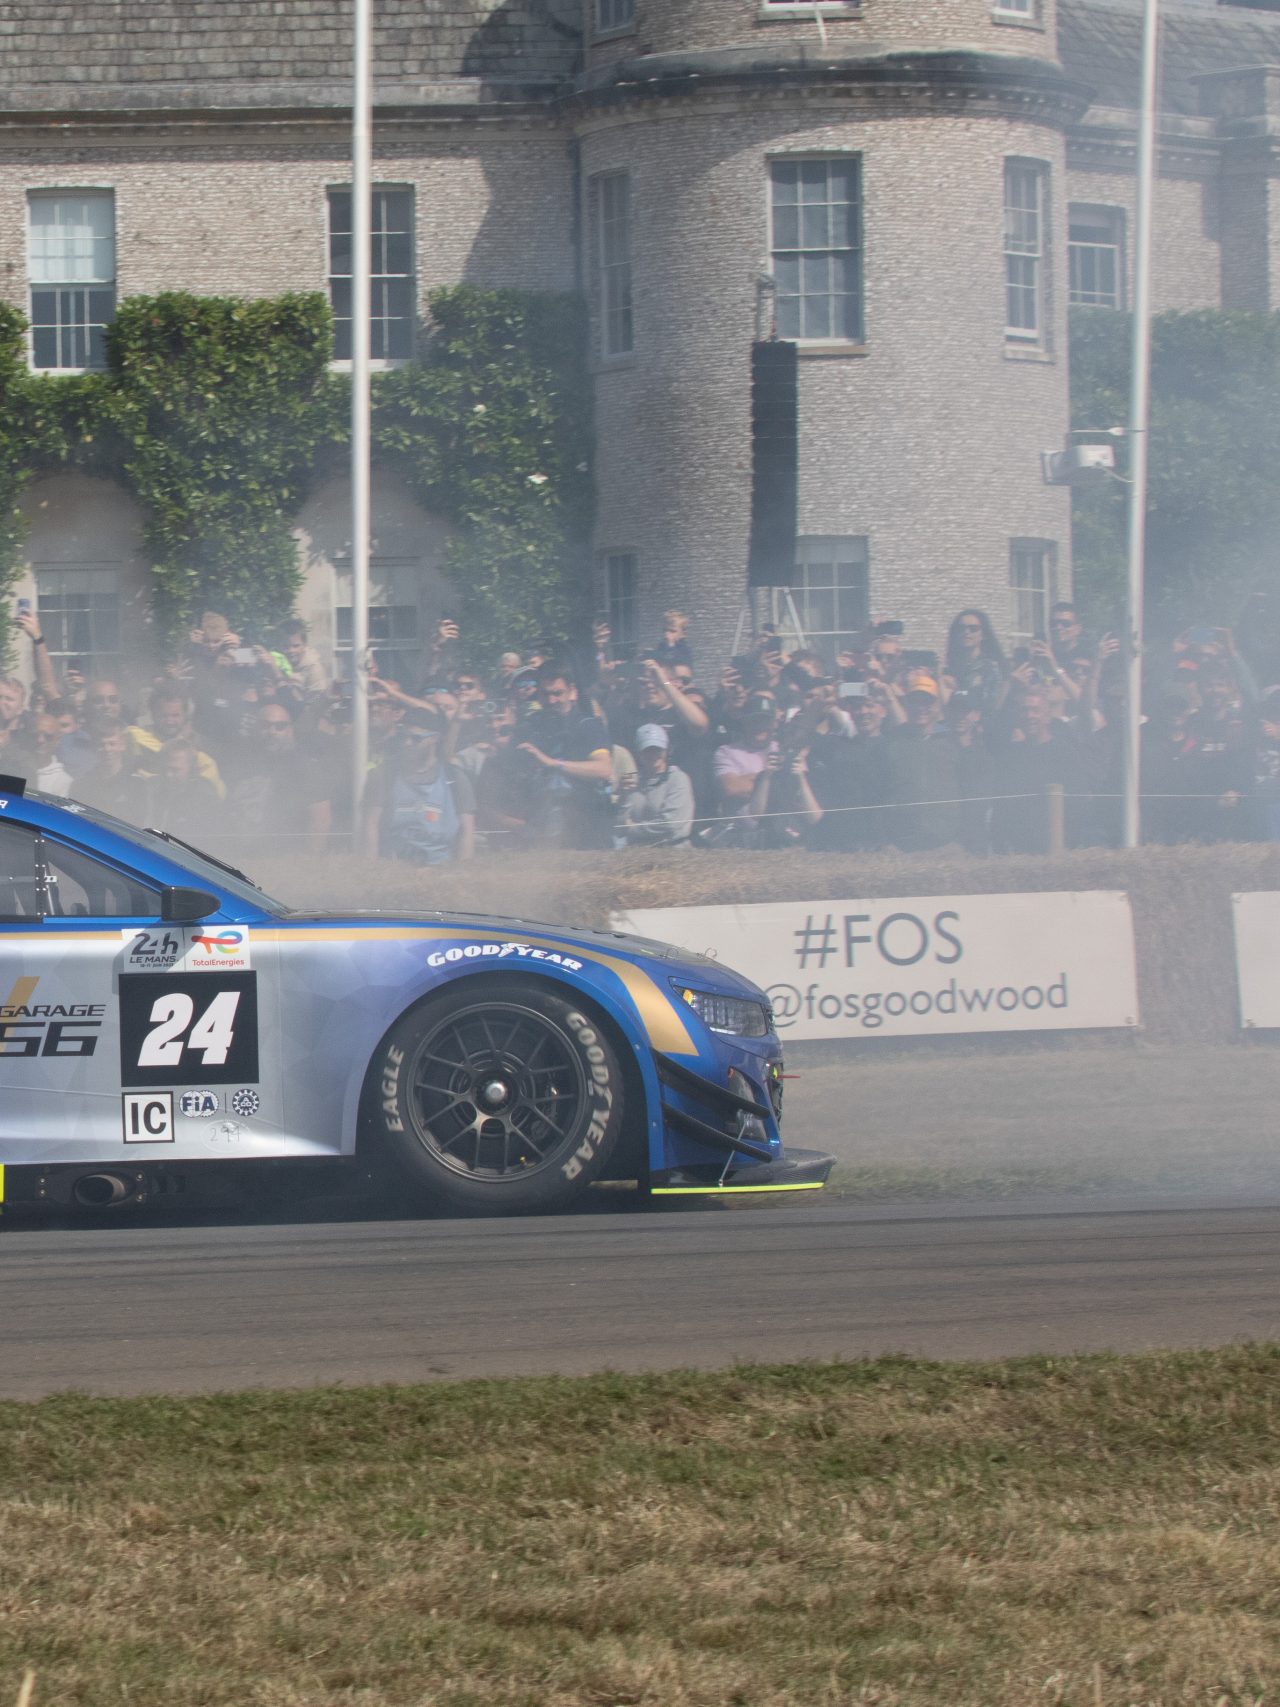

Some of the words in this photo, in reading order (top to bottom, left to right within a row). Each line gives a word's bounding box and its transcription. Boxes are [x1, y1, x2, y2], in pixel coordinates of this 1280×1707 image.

[145, 955, 176, 963] MANS
[192, 958, 245, 967] TotalEnergies
[427, 942, 583, 971] GOODYEAR
[793, 911, 964, 970] #FOS
[764, 972, 1069, 1028] @fosgoodwood
[137, 992, 241, 1067] 24
[381, 1044, 405, 1133] EAGLE
[561, 1012, 613, 1180] GOODYEAR
[131, 1101, 167, 1135] IC
